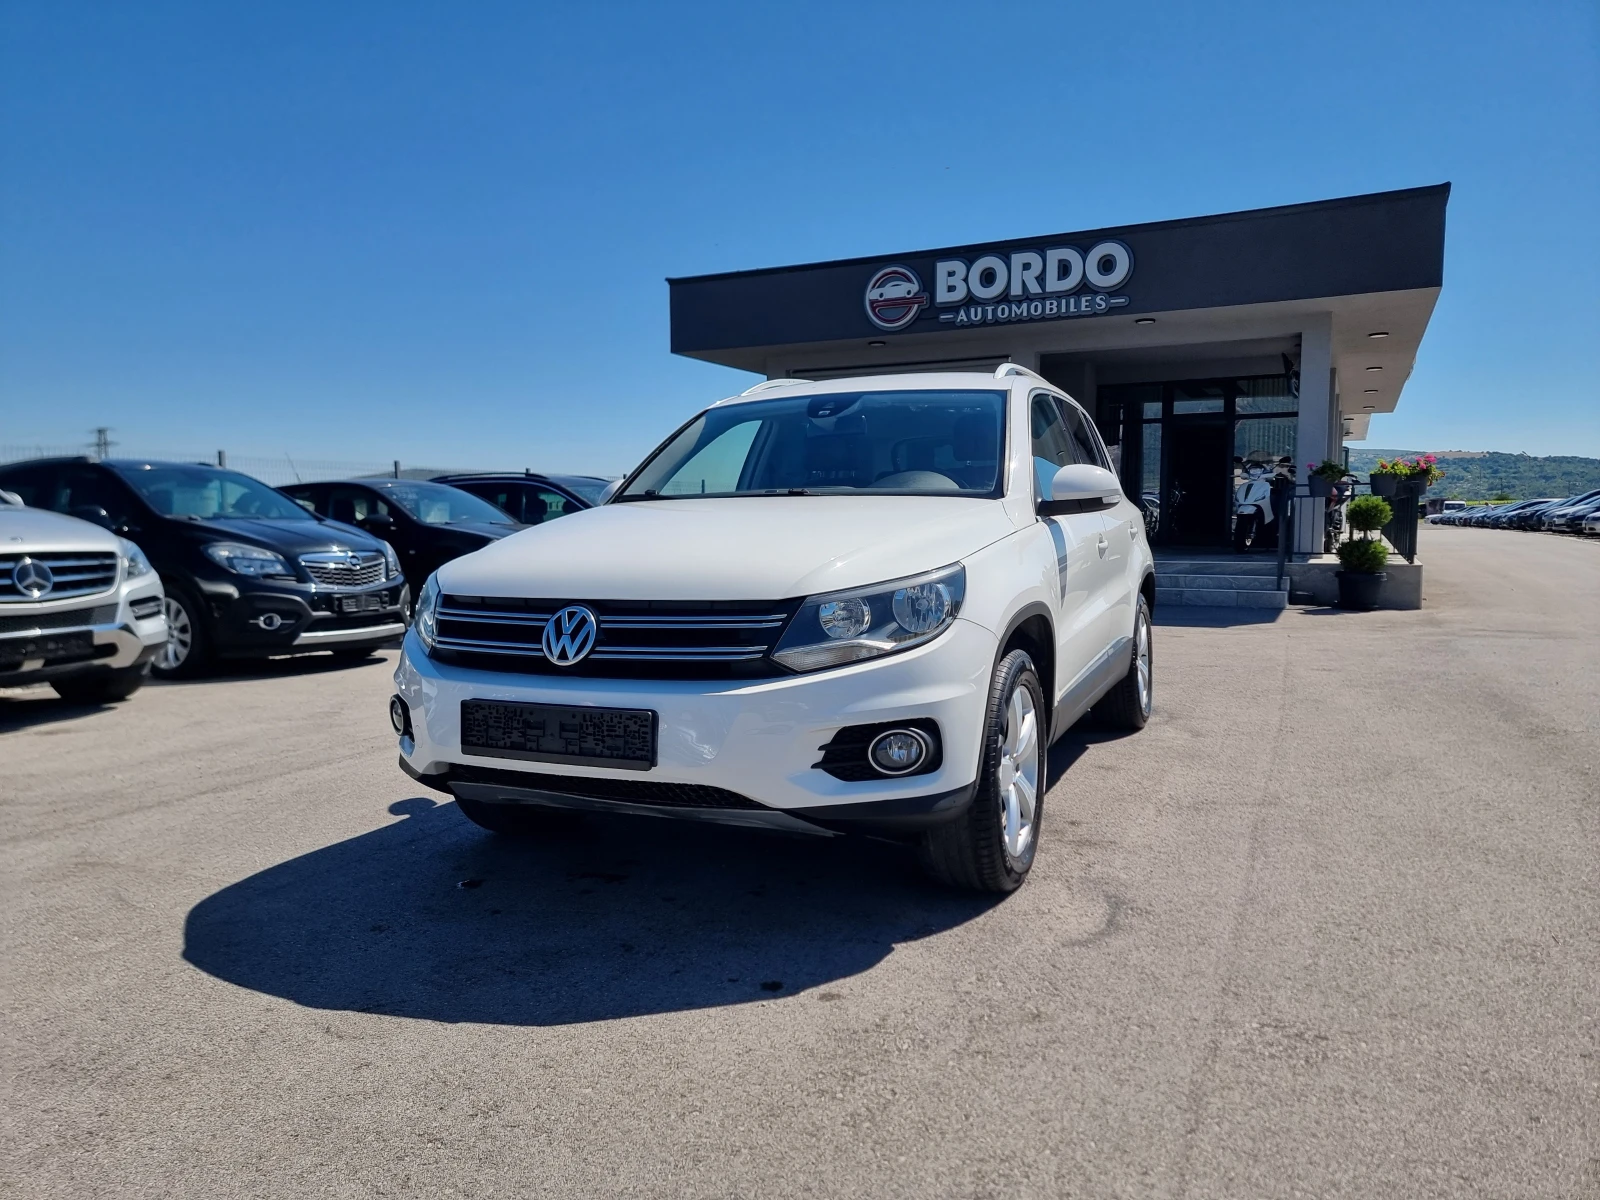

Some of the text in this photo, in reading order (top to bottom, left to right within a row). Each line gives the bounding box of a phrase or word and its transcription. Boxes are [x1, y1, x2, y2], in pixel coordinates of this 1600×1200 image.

[936, 242, 1130, 303] BORDO
[957, 296, 1106, 322] AUTOMOBILES
[543, 606, 596, 666] VW
